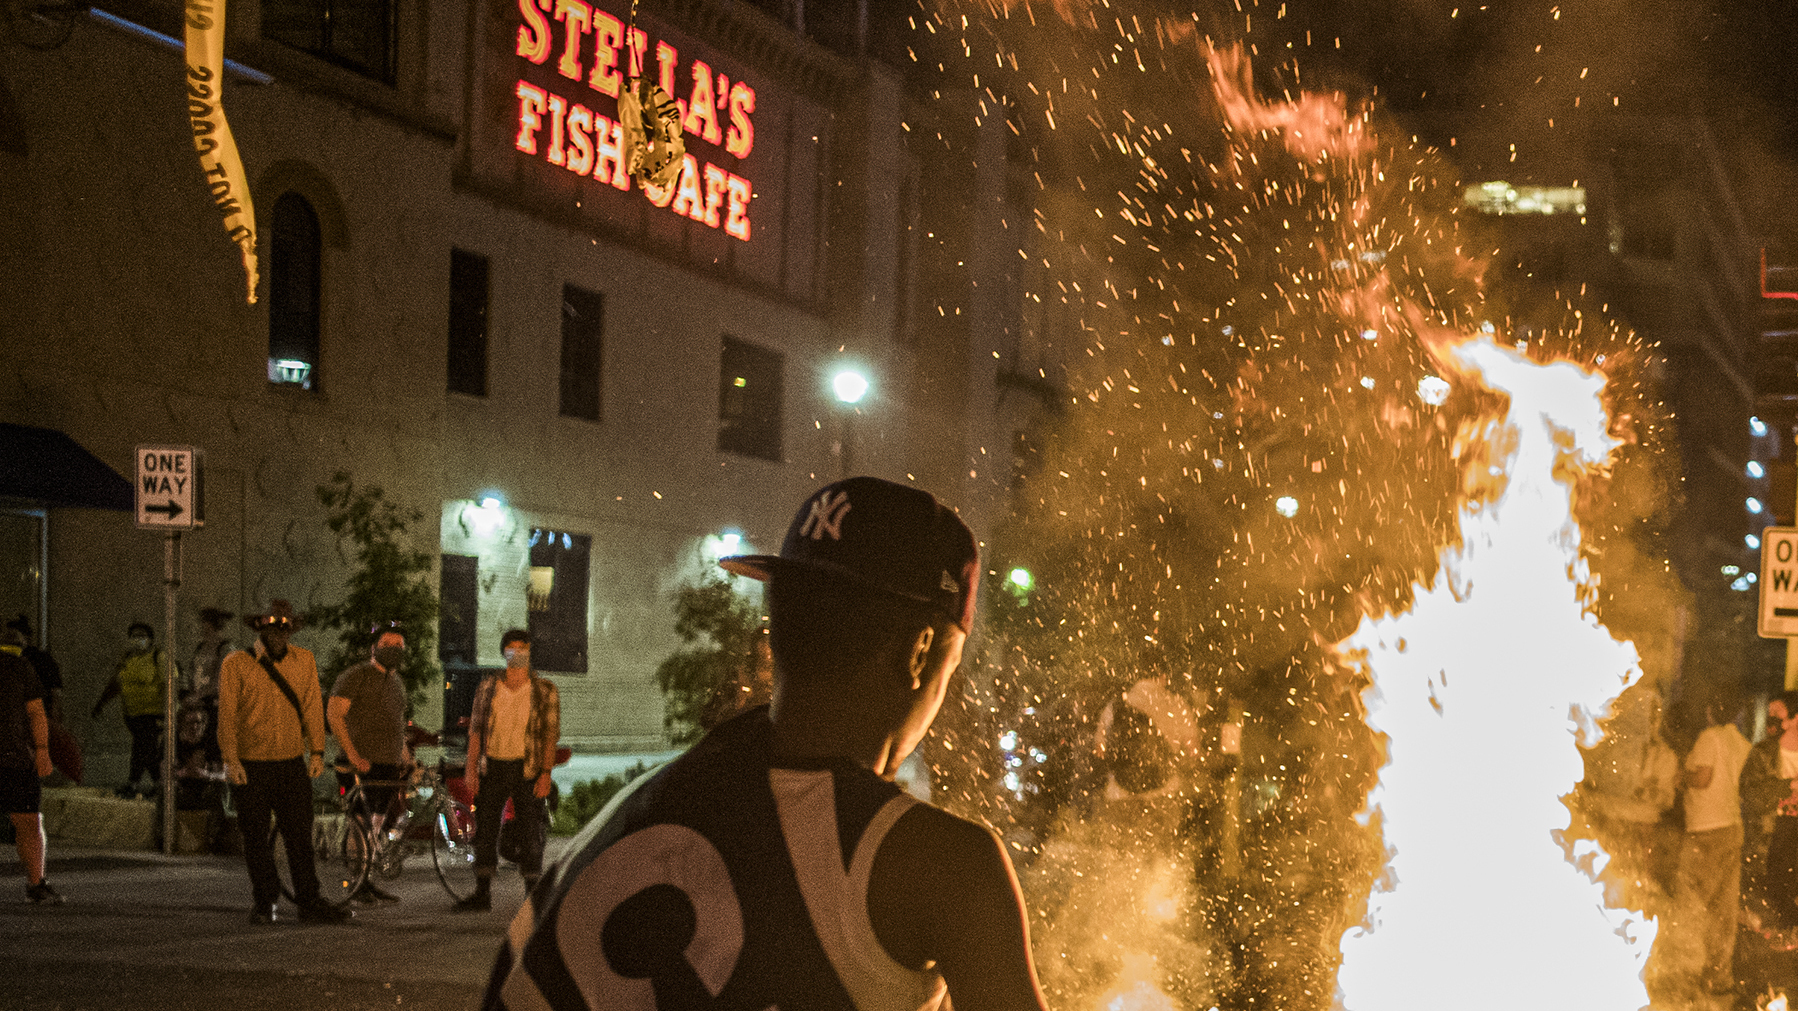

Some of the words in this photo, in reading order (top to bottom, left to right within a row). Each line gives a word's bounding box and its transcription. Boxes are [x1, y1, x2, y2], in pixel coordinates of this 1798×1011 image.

[516, 79, 631, 192] FISH
[644, 152, 752, 242] AFE
[144, 453, 186, 473] ONE
[143, 476, 187, 495] WAY
